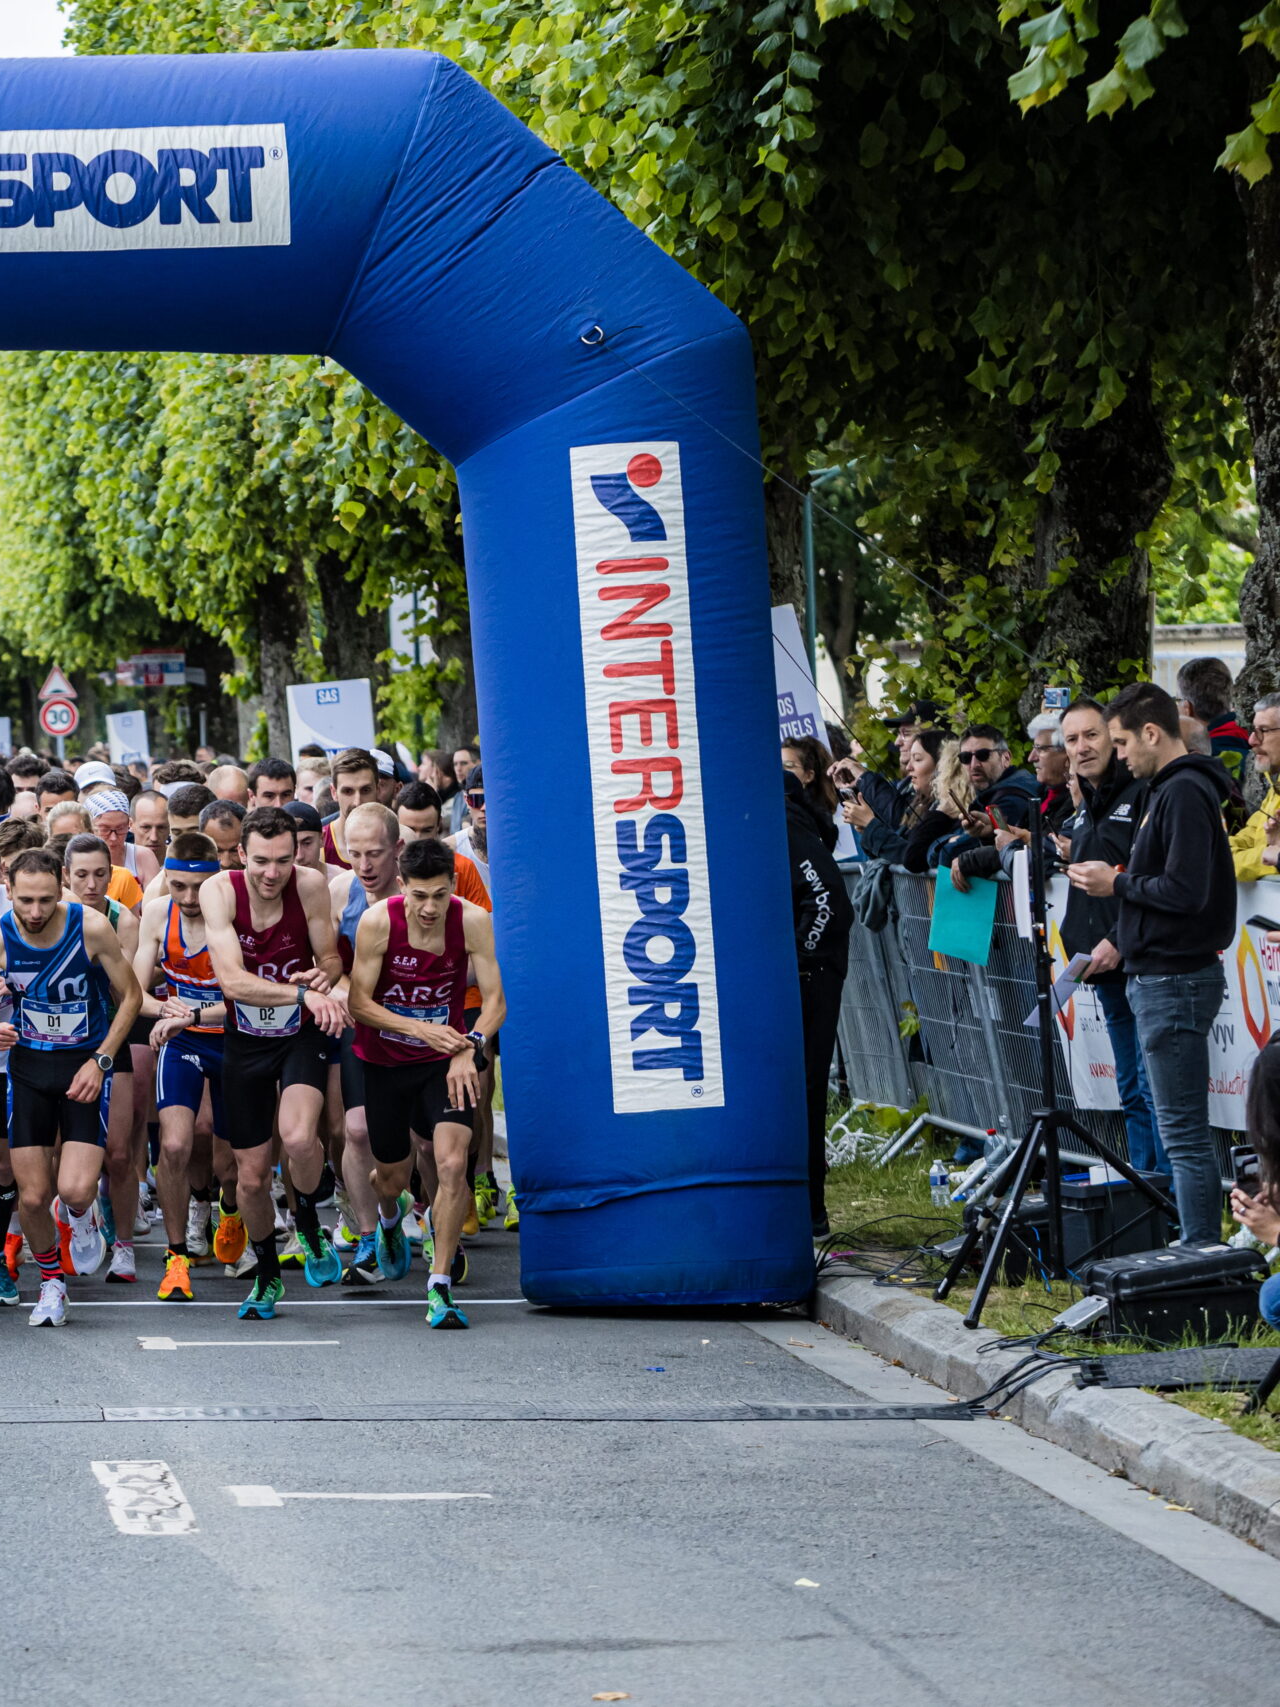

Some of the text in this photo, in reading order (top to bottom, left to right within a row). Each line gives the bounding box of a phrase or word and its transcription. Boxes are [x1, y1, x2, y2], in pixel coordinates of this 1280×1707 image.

[318, 688, 338, 704] SAS
[48, 708, 70, 725] 30
[800, 859, 825, 892] new
[393, 955, 418, 967] S.E.P.
[47, 1015, 61, 1028] D1
[259, 1007, 276, 1021] D2
